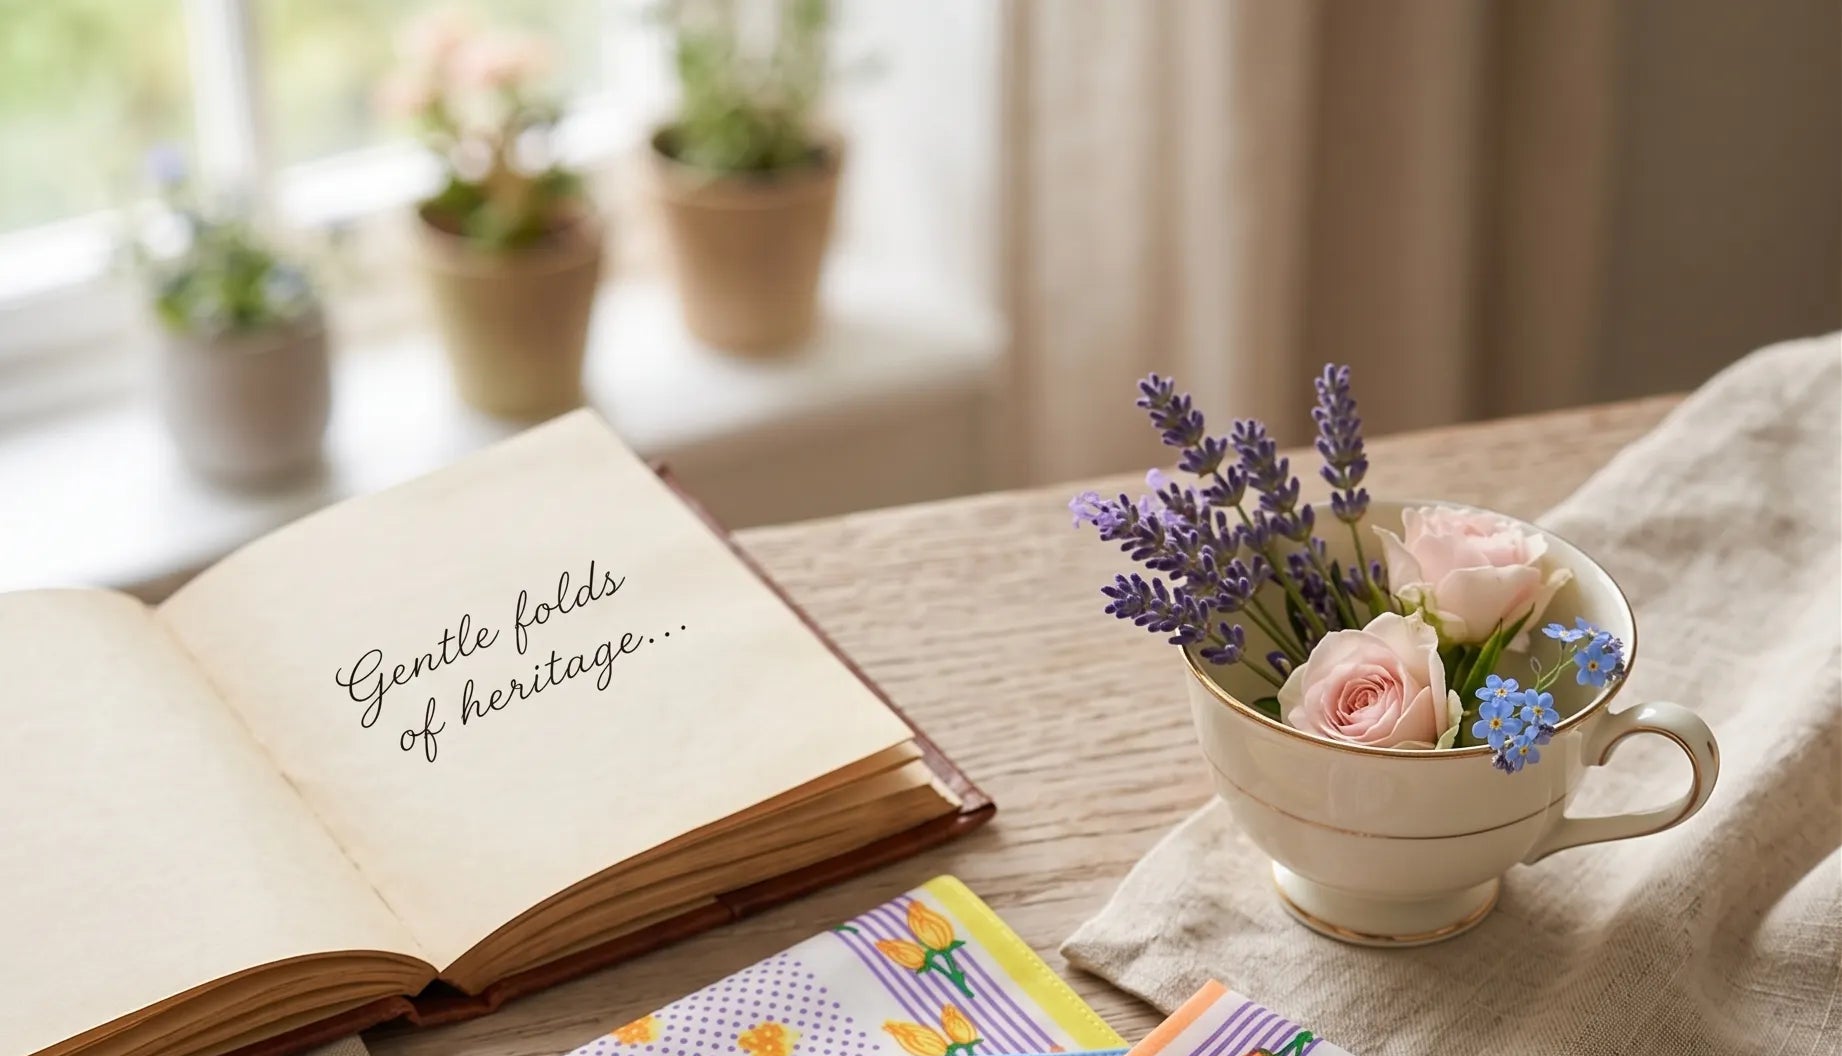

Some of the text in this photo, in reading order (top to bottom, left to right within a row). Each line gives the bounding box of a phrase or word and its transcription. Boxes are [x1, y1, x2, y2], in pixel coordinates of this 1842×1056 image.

[335, 559, 626, 729] Gentle folds
[399, 624, 686, 763] of heritage...
